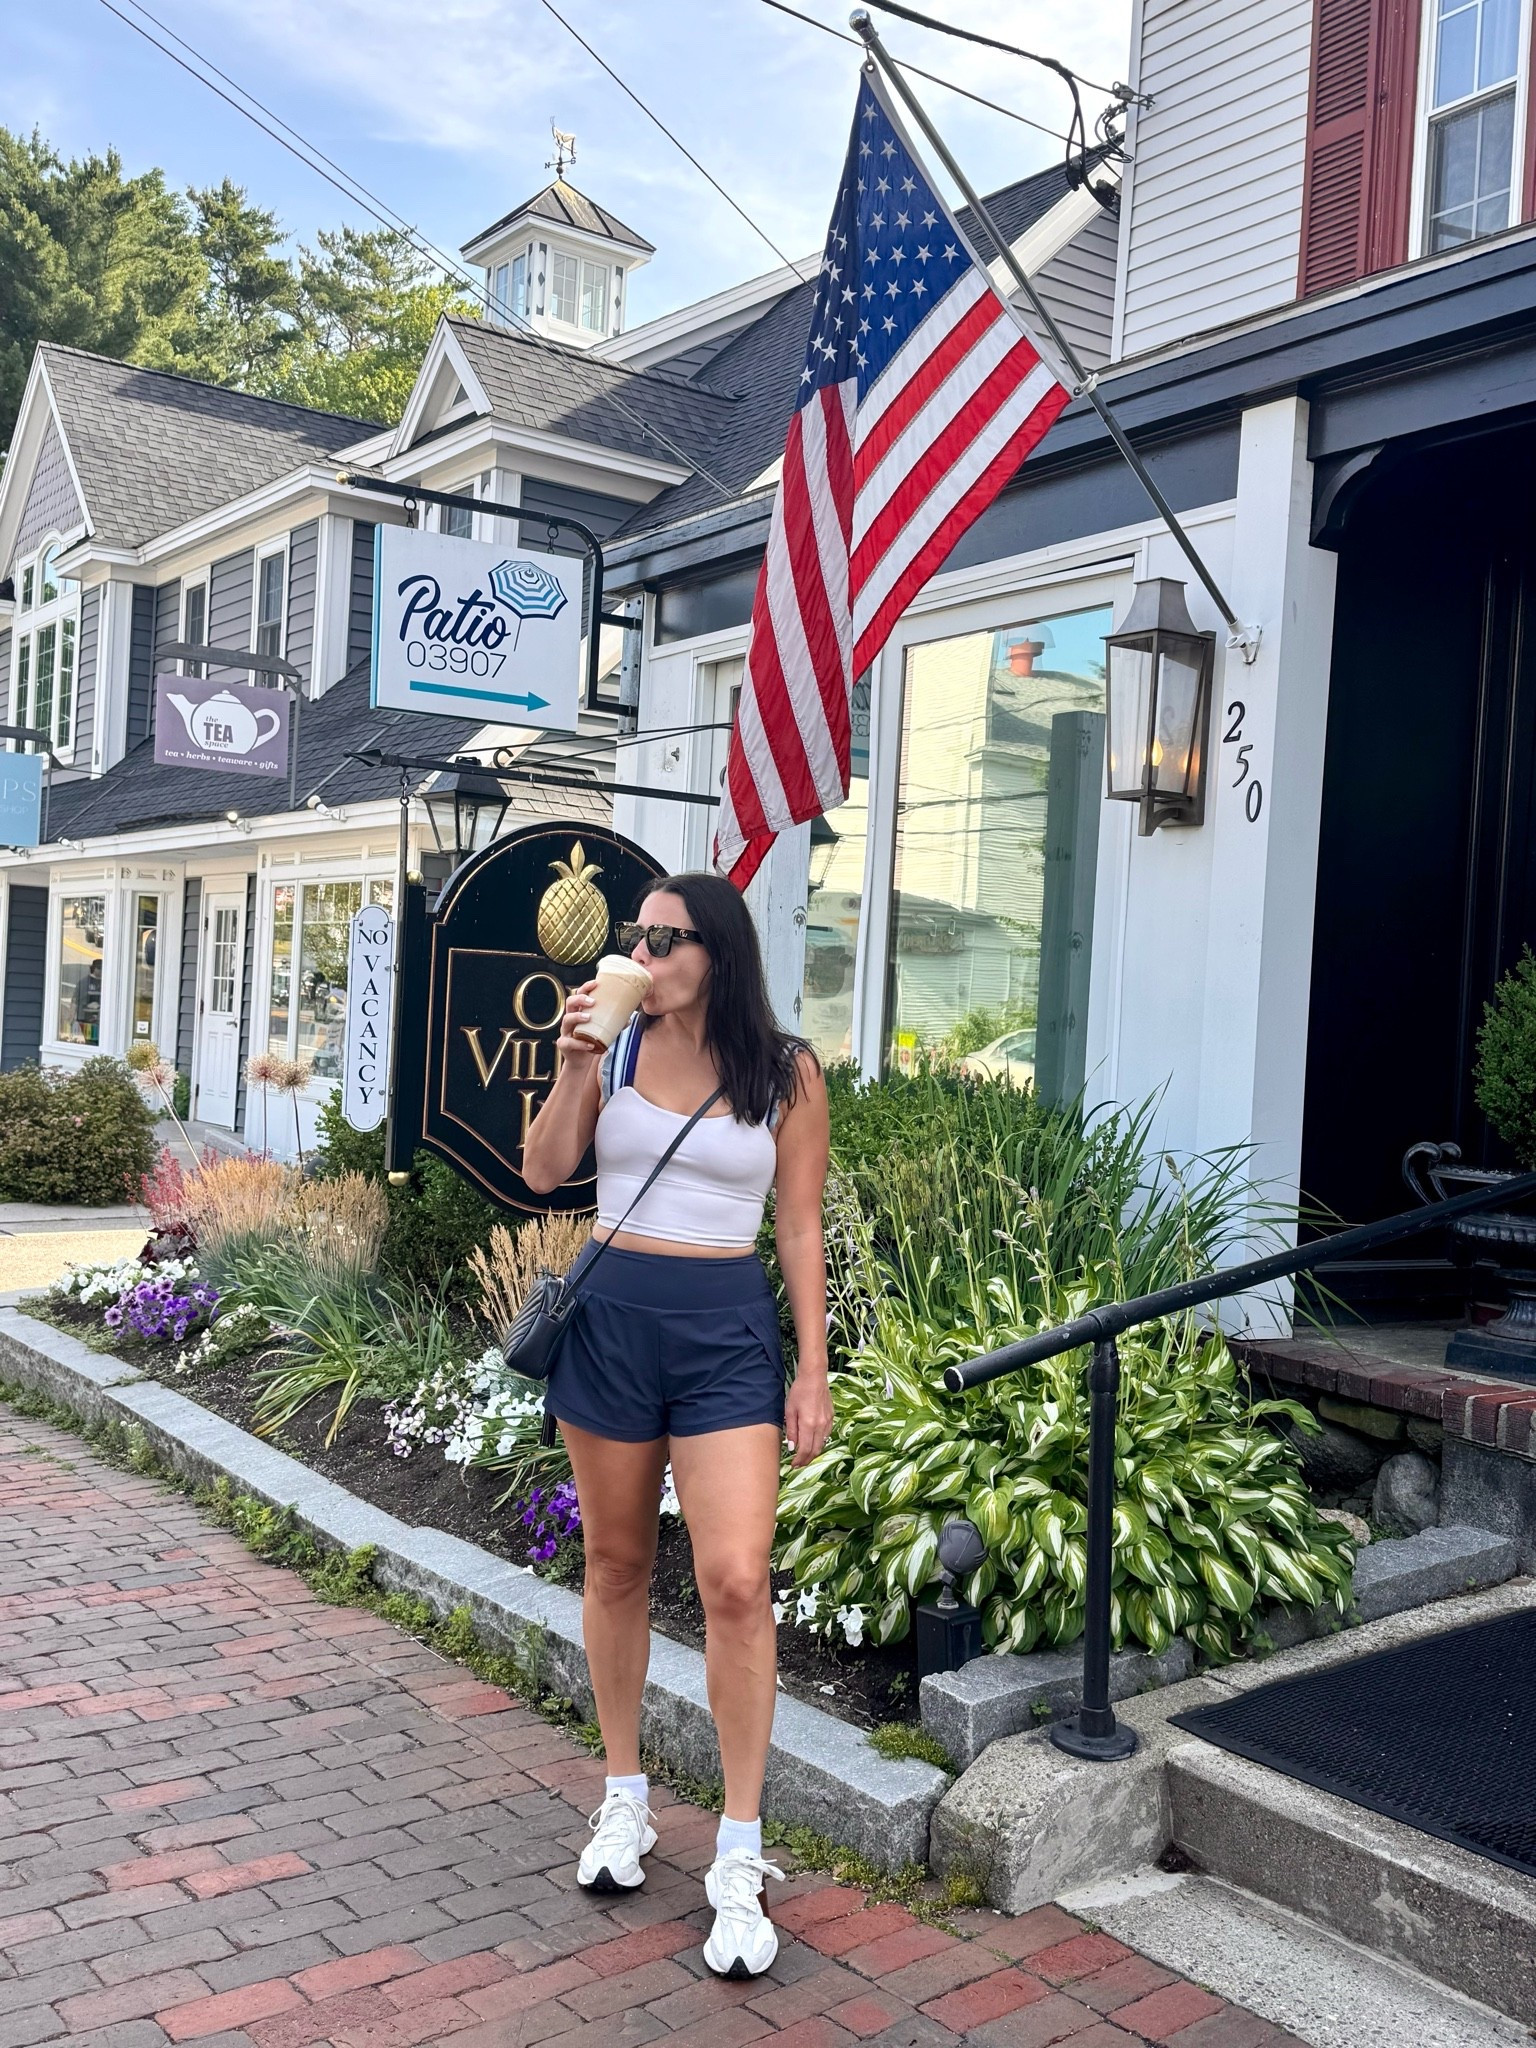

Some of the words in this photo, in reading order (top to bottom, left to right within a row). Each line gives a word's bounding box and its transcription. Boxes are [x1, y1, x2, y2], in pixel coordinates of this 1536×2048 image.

[397, 574, 511, 650] Patio
[406, 640, 507, 679] 03907
[205, 715, 219, 723] the
[203, 722, 234, 744] TEA
[204, 740, 229, 749] space
[164, 749, 179, 758] tea
[185, 751, 211, 762] herbs
[217, 755, 253, 767] teaware
[258, 760, 279, 771] gifts
[357, 929, 389, 946] NO
[358, 954, 381, 1105] VACANCY
